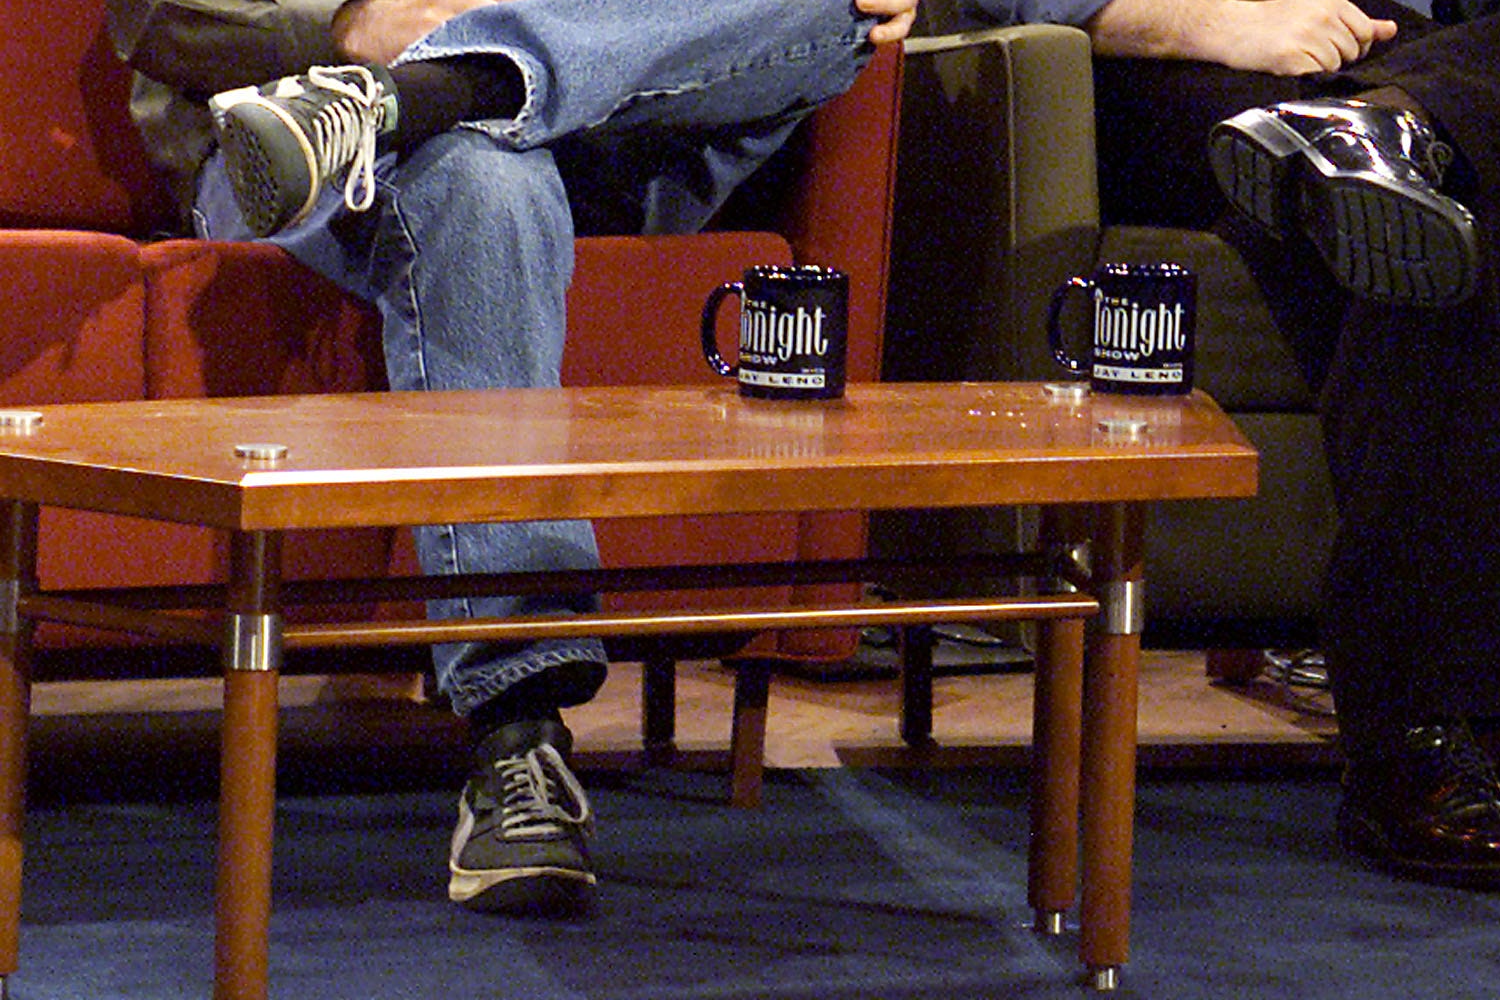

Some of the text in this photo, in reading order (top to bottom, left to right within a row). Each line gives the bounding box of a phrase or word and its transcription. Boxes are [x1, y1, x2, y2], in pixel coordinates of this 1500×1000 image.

[1094, 288, 1186, 356] Tonight
[1130, 371, 1182, 380] LENO
[768, 376, 824, 385] LENO
